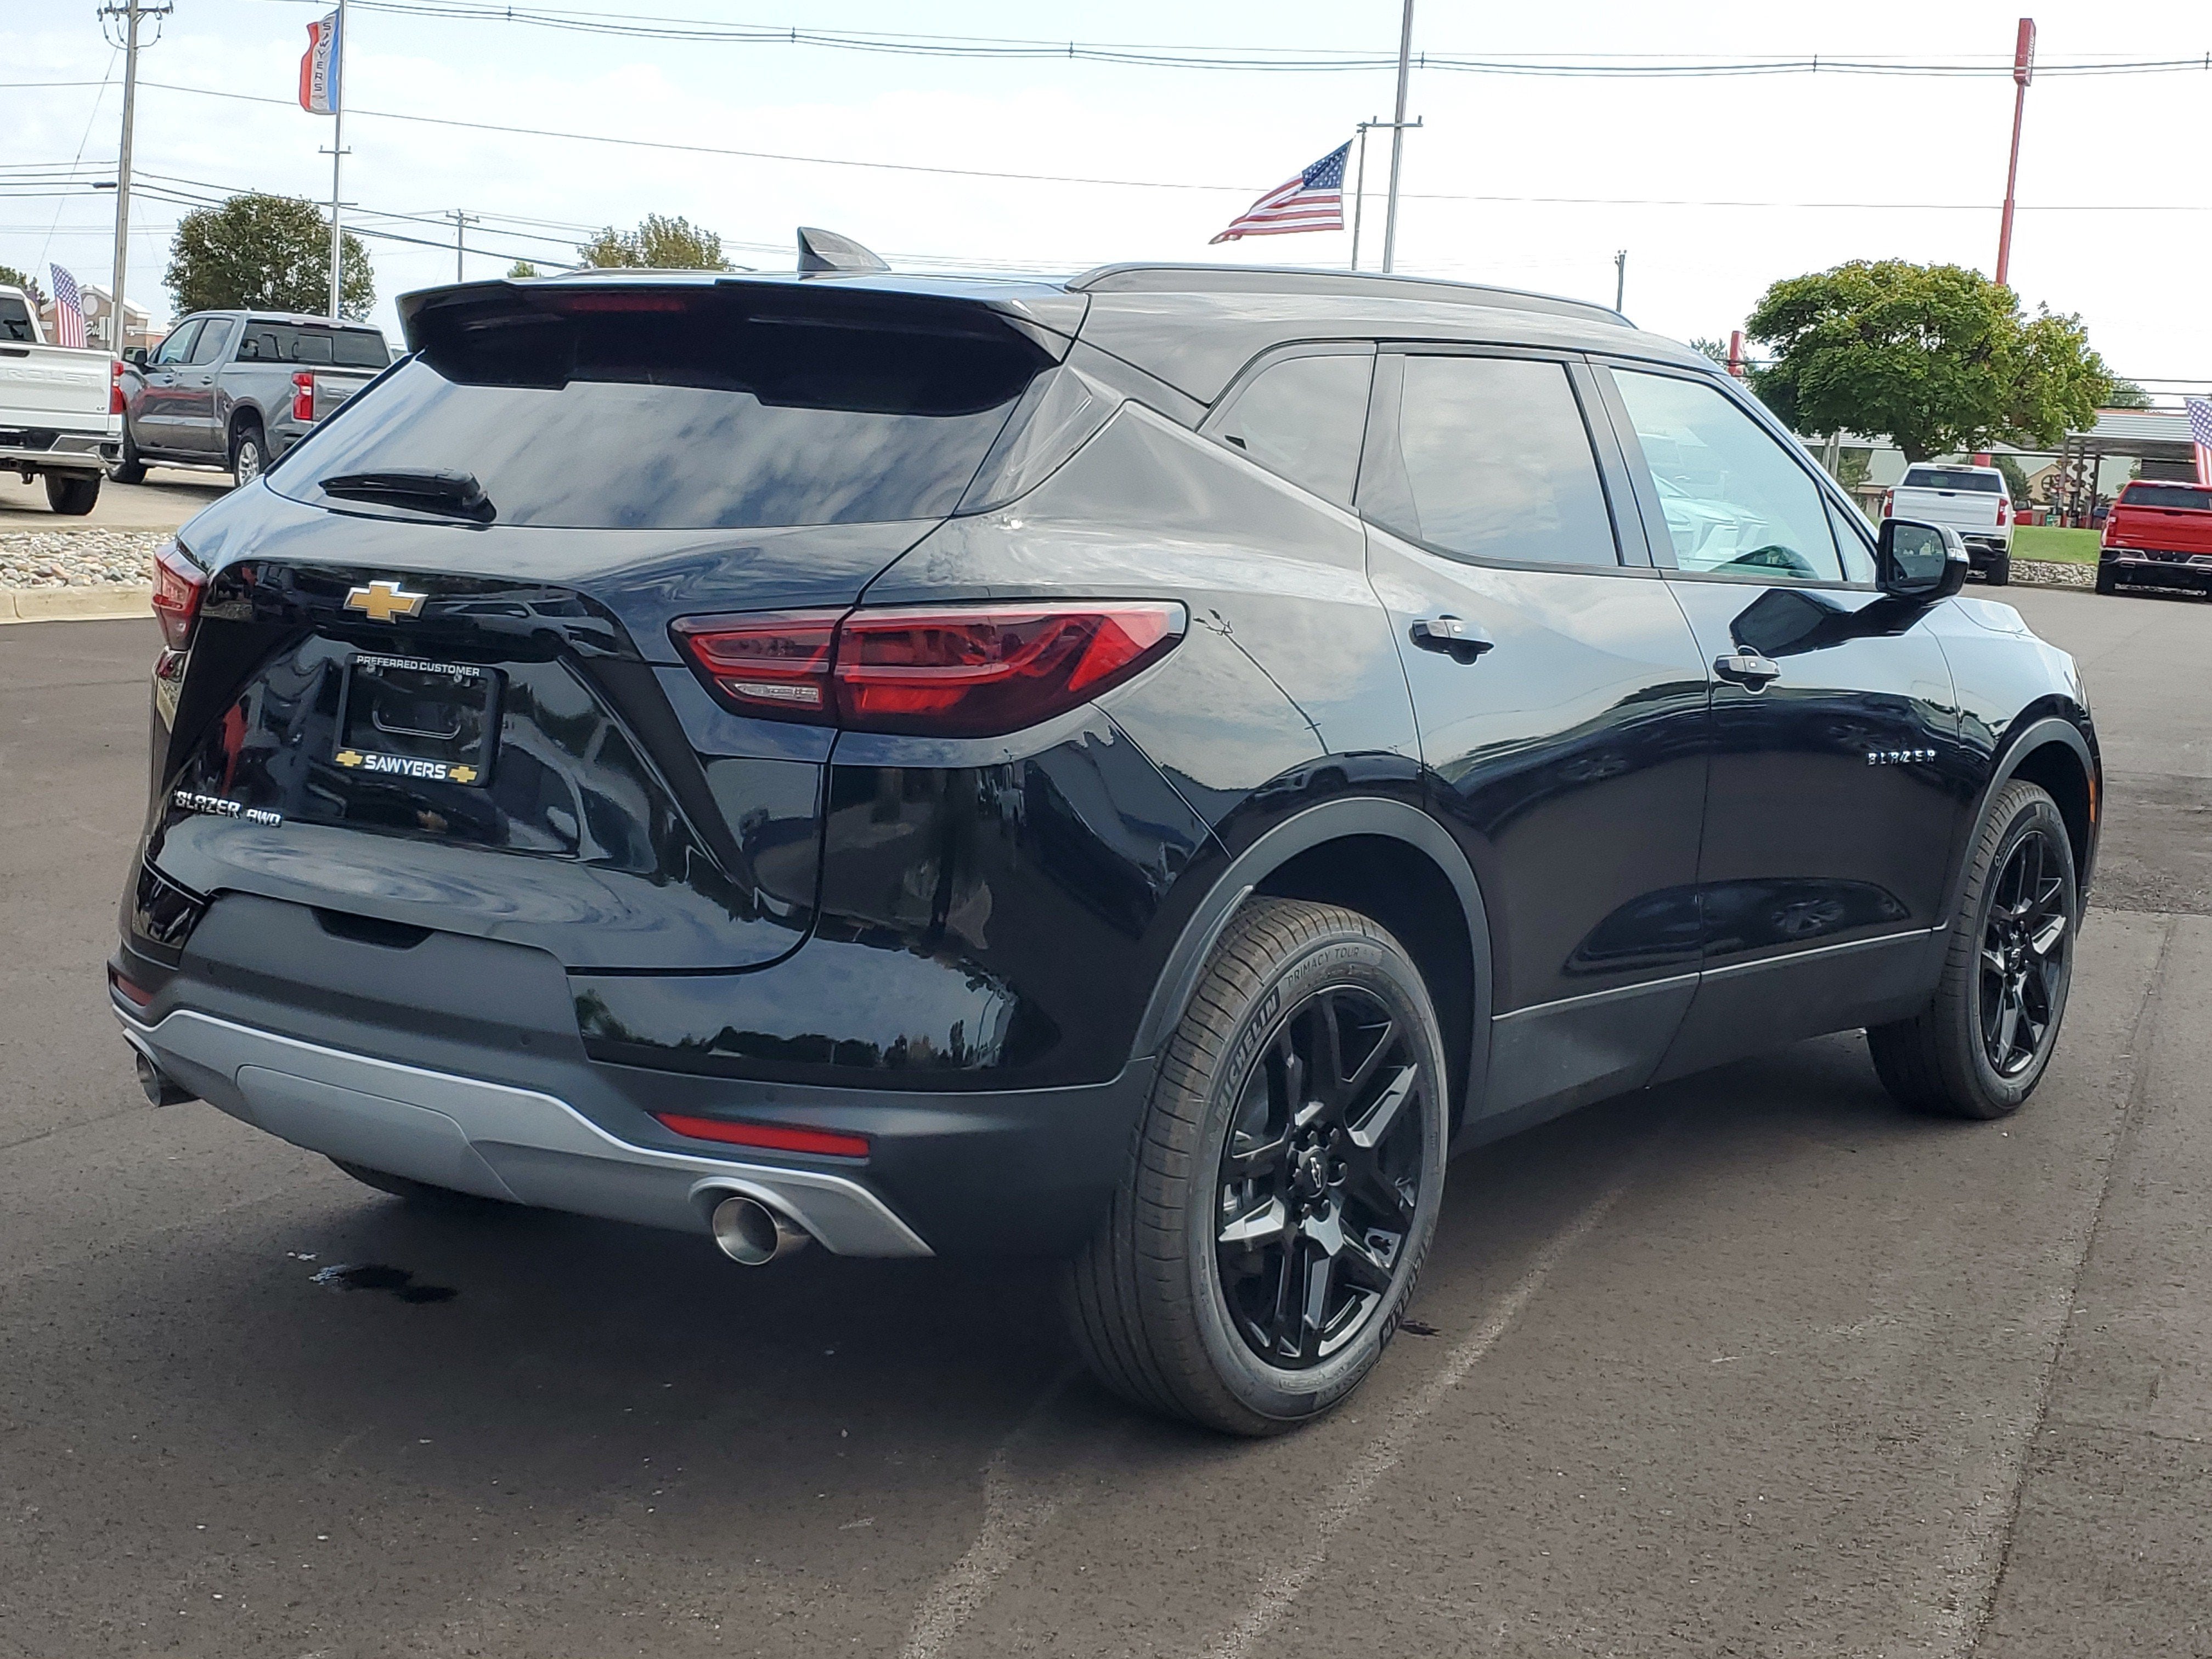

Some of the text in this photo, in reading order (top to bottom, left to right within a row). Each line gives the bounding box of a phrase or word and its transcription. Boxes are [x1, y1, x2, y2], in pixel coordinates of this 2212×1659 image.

[357, 655, 480, 676] PREFERRED CUSTOMER
[364, 754, 447, 779] SAWYERS
[1868, 749, 1936, 765] BLAZER
[176, 791, 282, 827] BLAZER AWD
[1215, 947, 1359, 1123] MICHELIN PRIMACY TOUR
